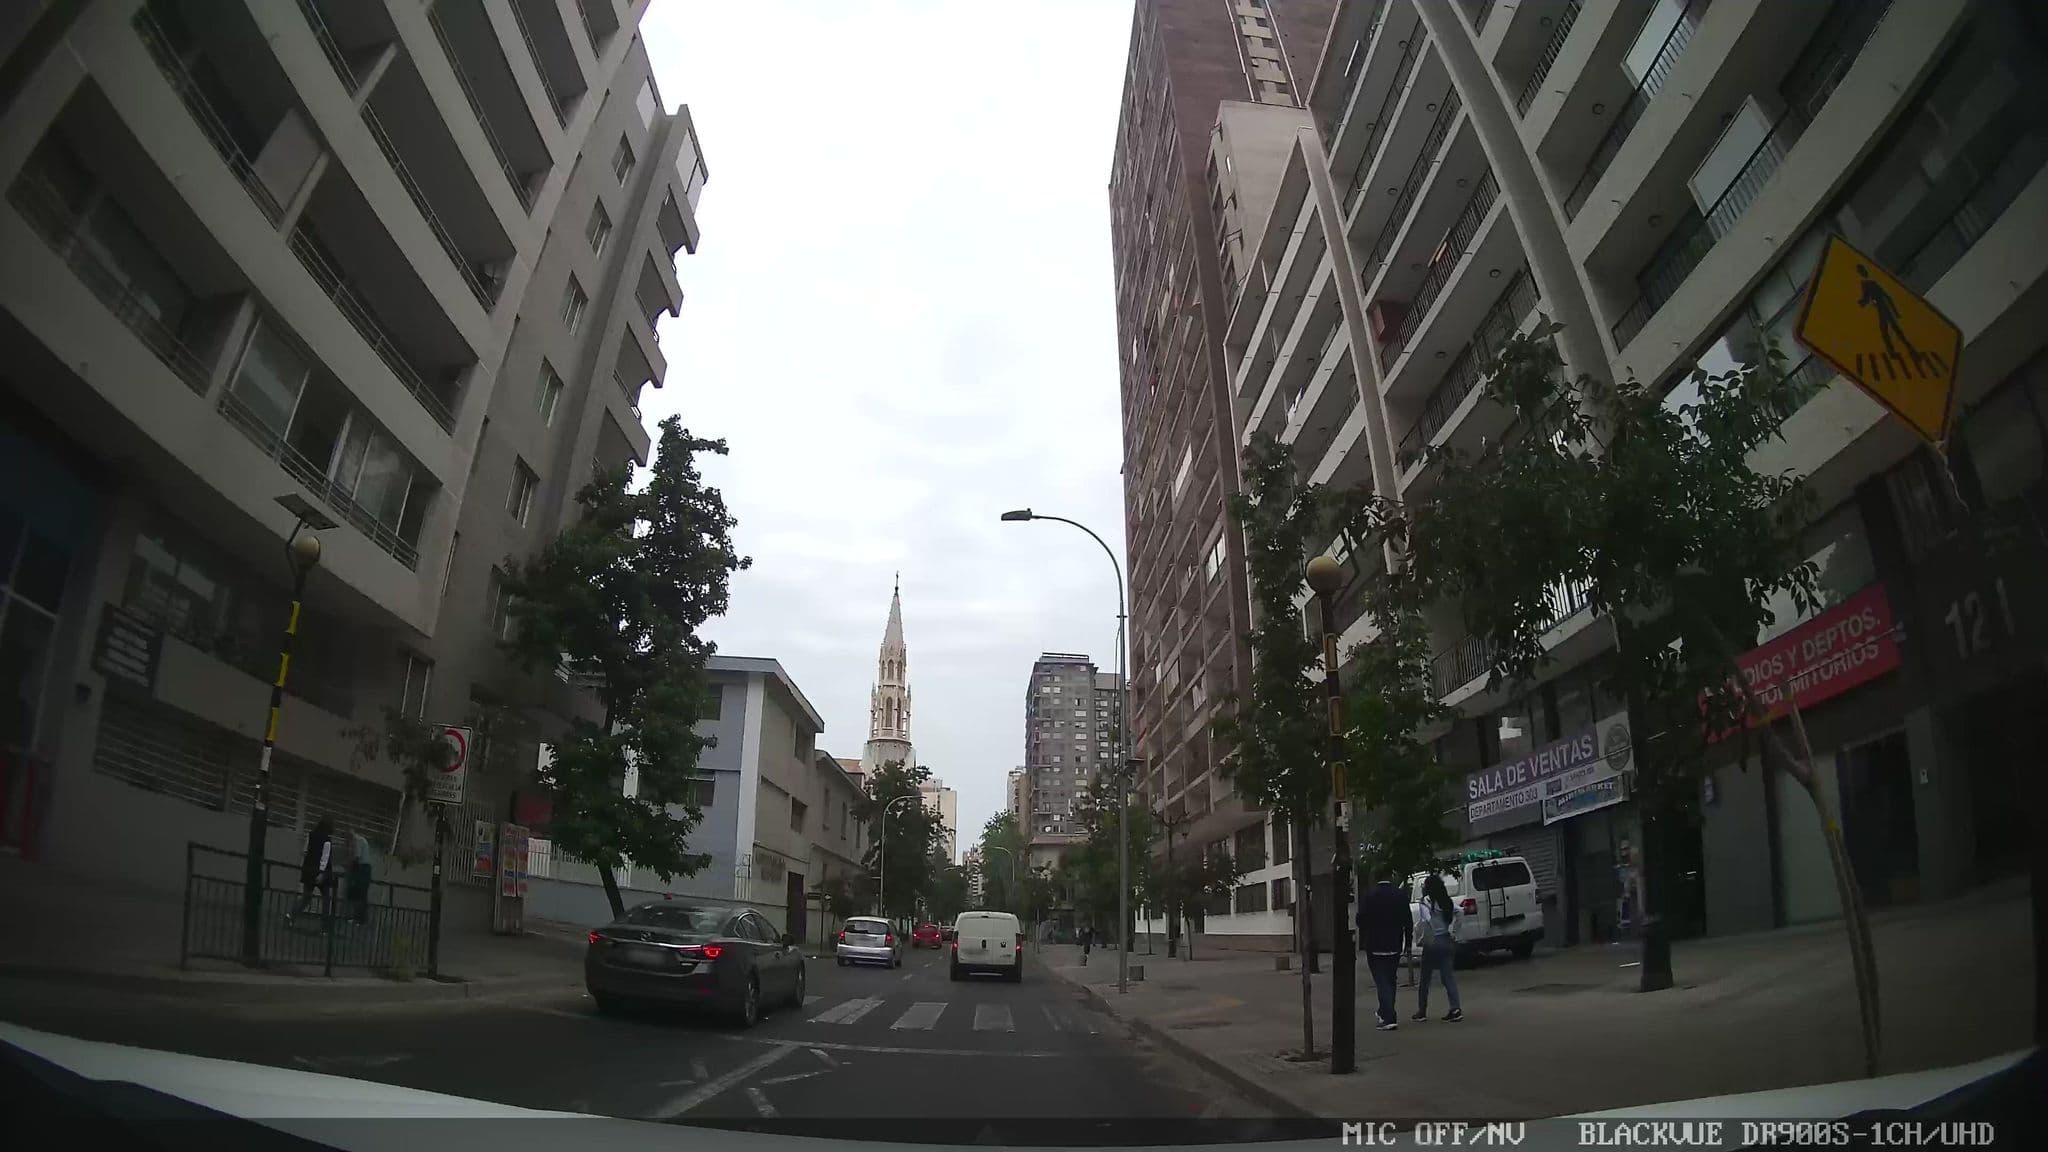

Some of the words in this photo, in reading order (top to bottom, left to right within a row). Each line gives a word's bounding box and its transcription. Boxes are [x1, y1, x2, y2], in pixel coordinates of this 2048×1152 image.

[1785, 644, 1797, 669] Y
[1802, 606, 1881, 662] DEPTOS.
[1944, 576, 2016, 661] 121
[1469, 770, 1504, 799] SALA
[1506, 761, 1527, 787] DE
[1528, 734, 1593, 777] VENTAS
[1470, 792, 1524, 819] DEPARTAMENTO
